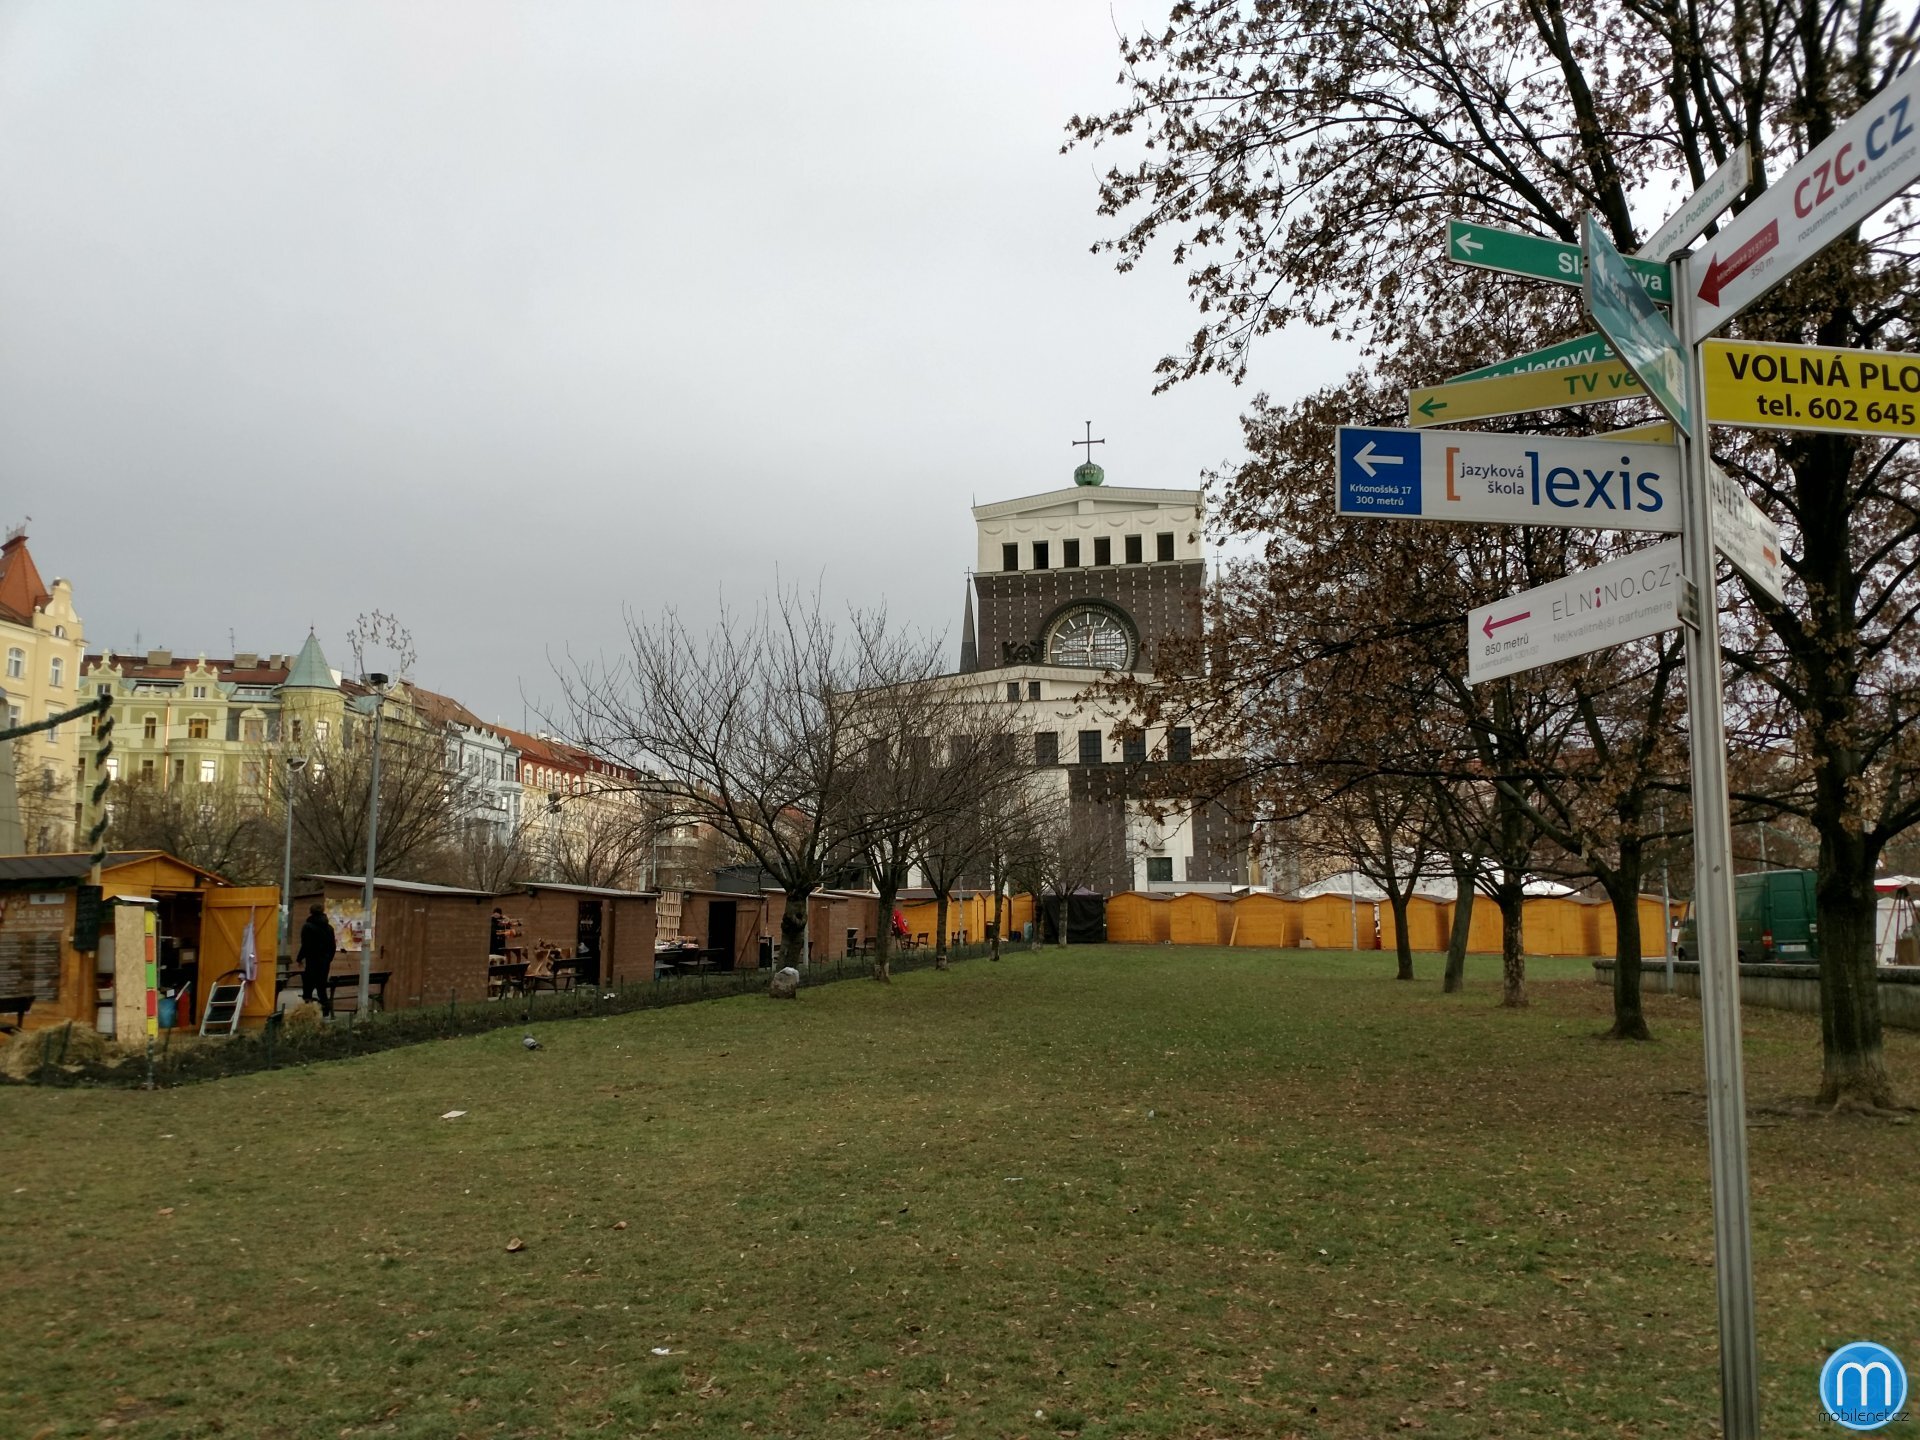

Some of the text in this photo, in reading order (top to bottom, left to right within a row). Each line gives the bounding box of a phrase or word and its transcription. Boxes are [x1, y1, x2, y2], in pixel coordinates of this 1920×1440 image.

[1794, 93, 1915, 219] CZC.CZ
[1726, 351, 1850, 388] VOLNÁ
[1563, 372, 1599, 395] TV
[1756, 393, 1916, 426] tel. 602 645
[1460, 462, 1525, 480] jazyková
[1350, 482, 1412, 495] Krkonošská 17
[1356, 494, 1404, 506] 300 metrů
[1487, 480, 1525, 496] škola
[1618, 599, 1673, 627] parfumerie
[1484, 632, 1530, 657] 850 metrů
